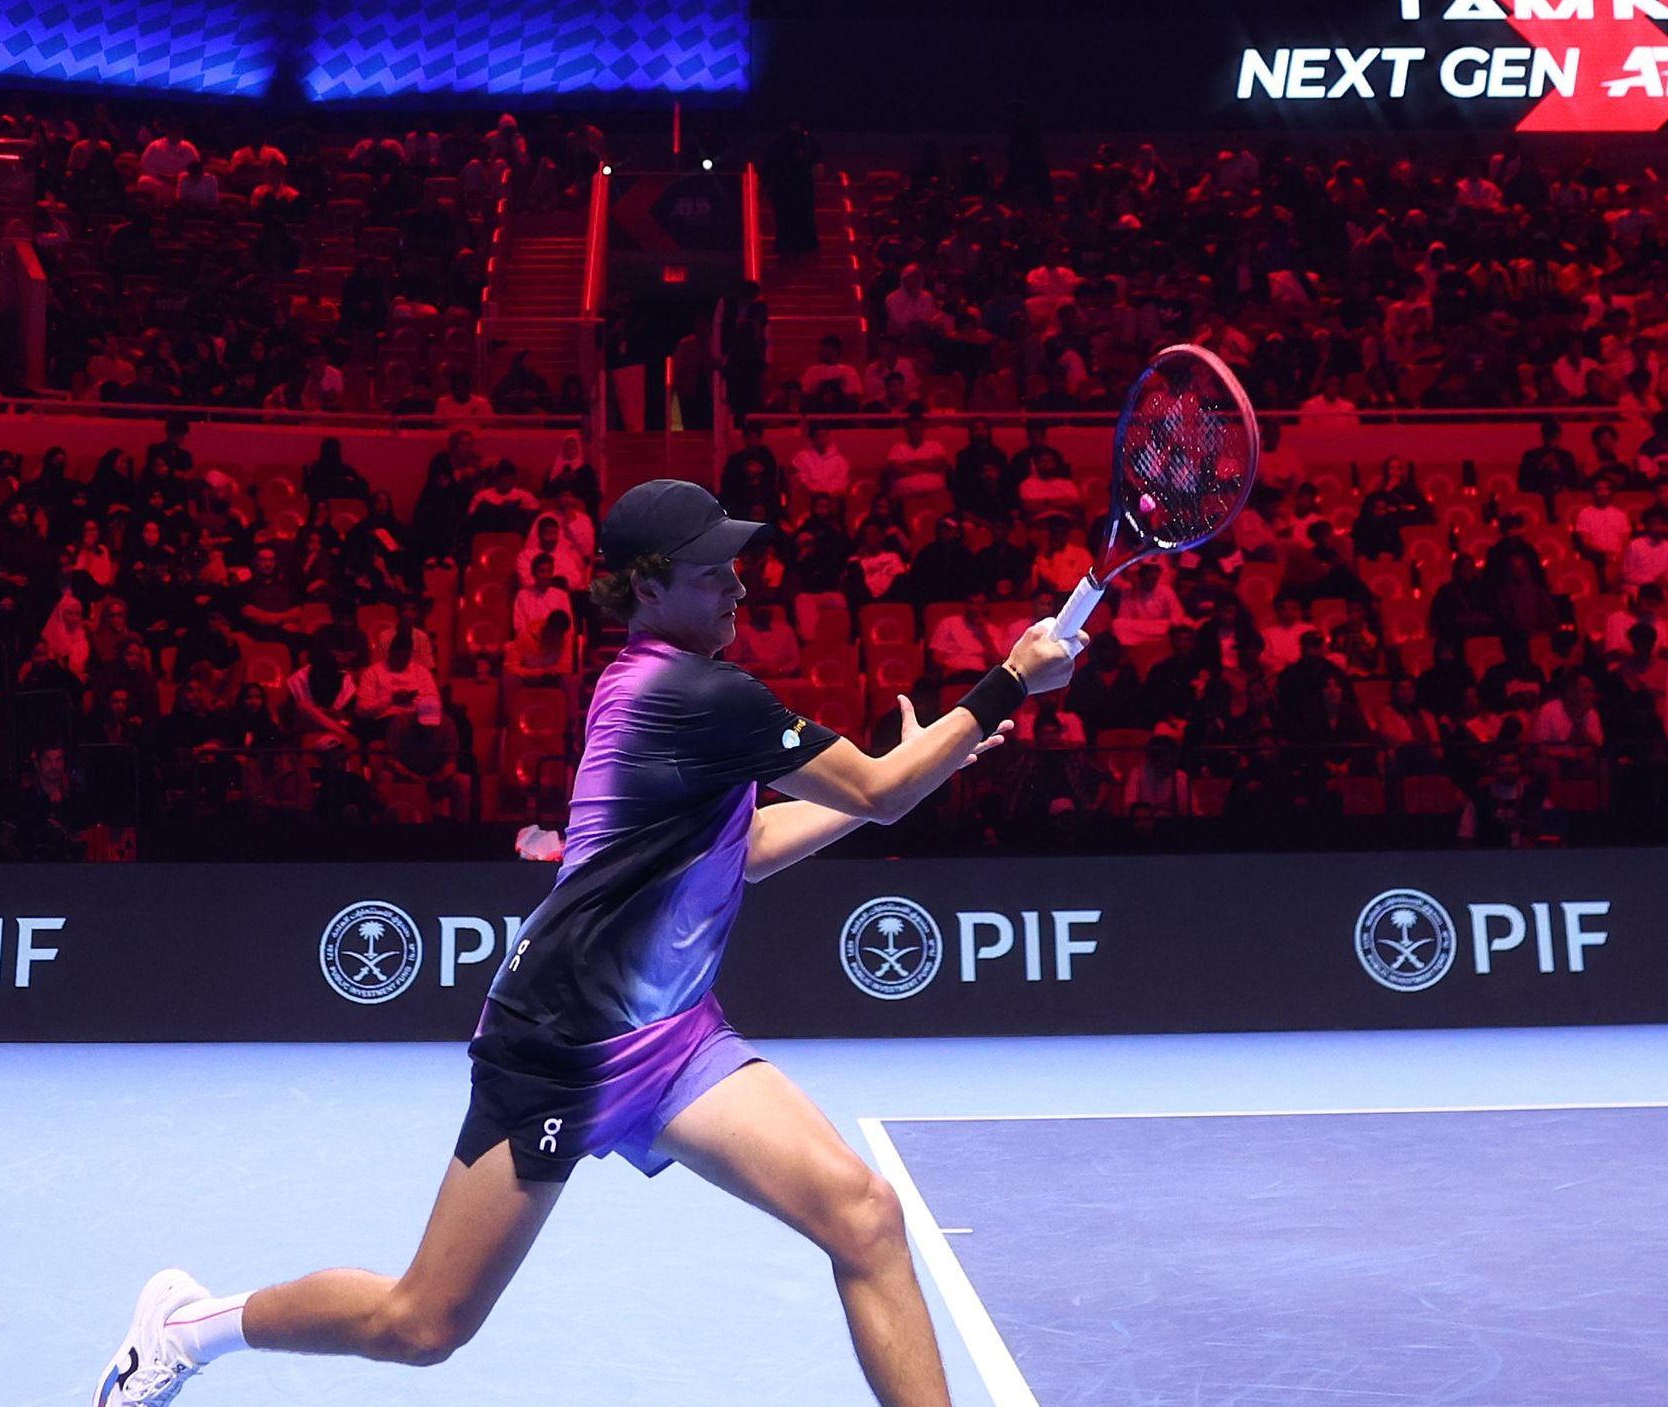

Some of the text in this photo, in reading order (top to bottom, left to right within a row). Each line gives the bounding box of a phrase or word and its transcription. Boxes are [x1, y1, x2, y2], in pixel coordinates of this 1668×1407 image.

[1237, 48, 1425, 99] NEXT
[1440, 47, 1580, 98] GEN
[957, 911, 1101, 982] PIF
[1468, 901, 1611, 974] PIF
